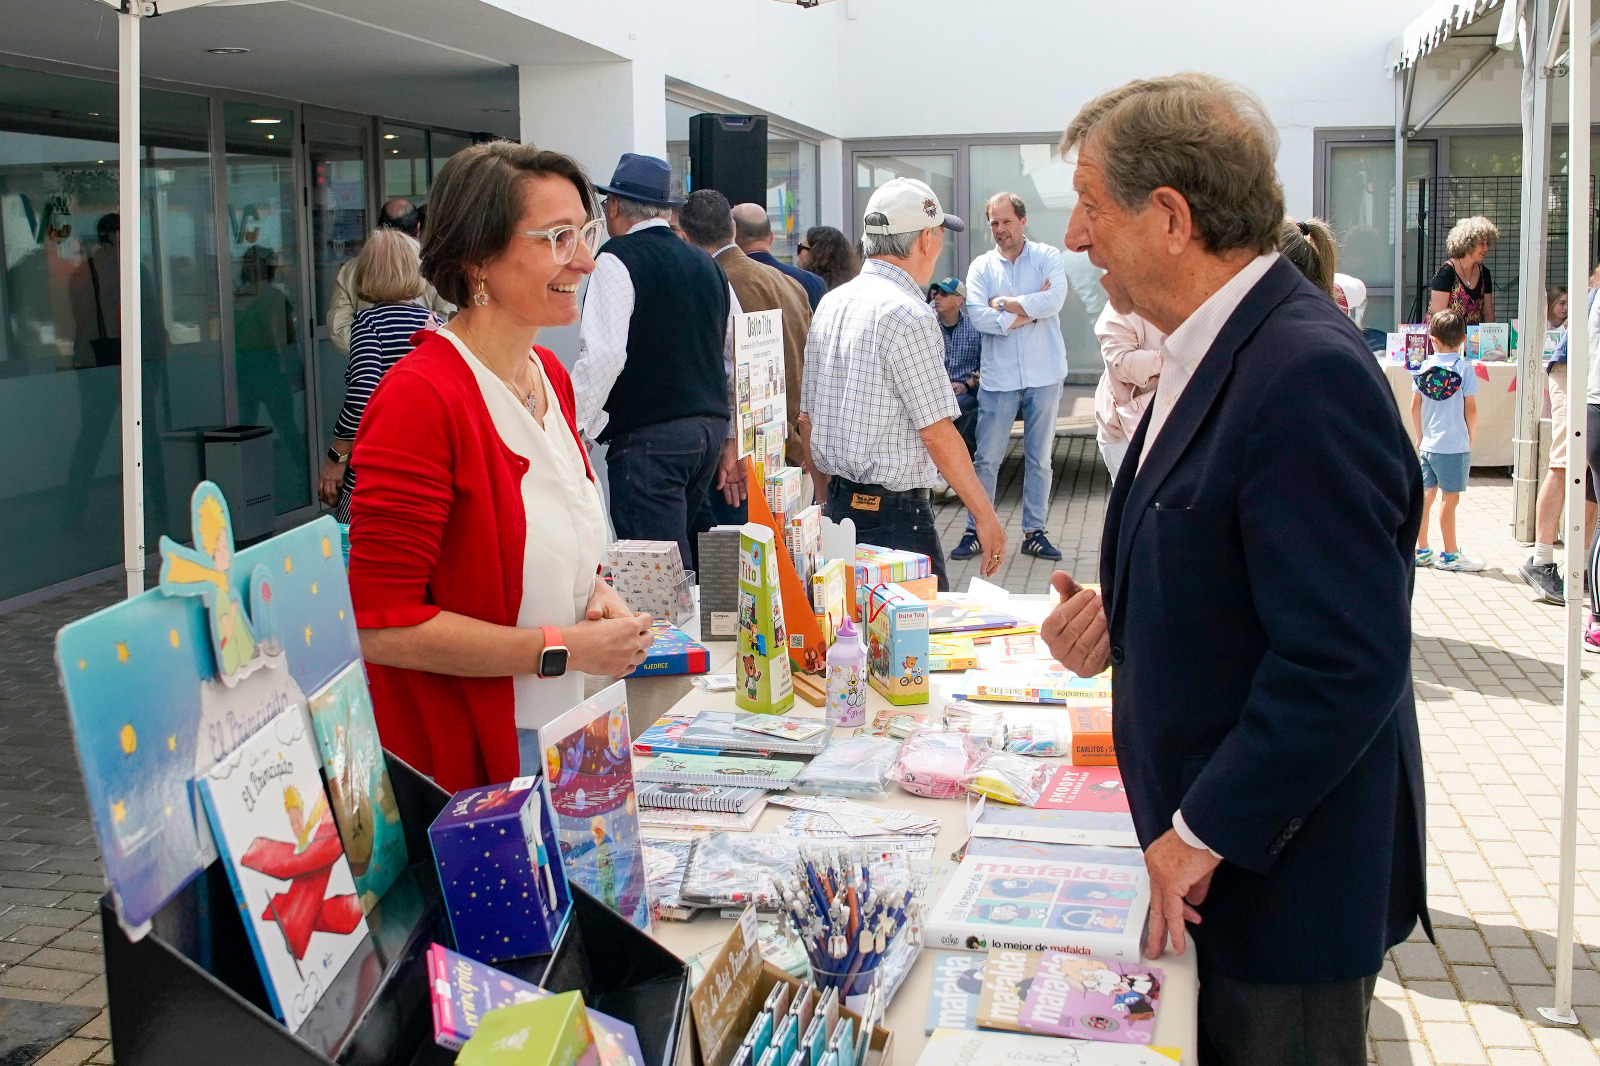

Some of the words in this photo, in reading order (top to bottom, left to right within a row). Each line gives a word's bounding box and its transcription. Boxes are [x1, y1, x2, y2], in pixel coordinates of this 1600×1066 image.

[741, 560, 757, 582] Tito
[643, 662, 669, 670] AJEDREZ
[989, 687, 1003, 695] Tito
[1004, 687, 1023, 695] Osito
[1076, 745, 1104, 753] CARLITOS
[250, 758, 293, 796] Principito
[1048, 771, 1080, 803] SNOOPY
[969, 873, 984, 882] de
[973, 863, 1131, 882] mafalda
[961, 881, 979, 901] mejor
[954, 900, 969, 908] lo
[992, 939, 1002, 949] lo
[1003, 941, 1033, 952] mejor
[1034, 943, 1048, 952] de
[1050, 945, 1092, 955] mafalda
[933, 956, 972, 1029] mafalda
[985, 951, 1027, 1022] mafalda
[1030, 953, 1080, 1025] mafalda
